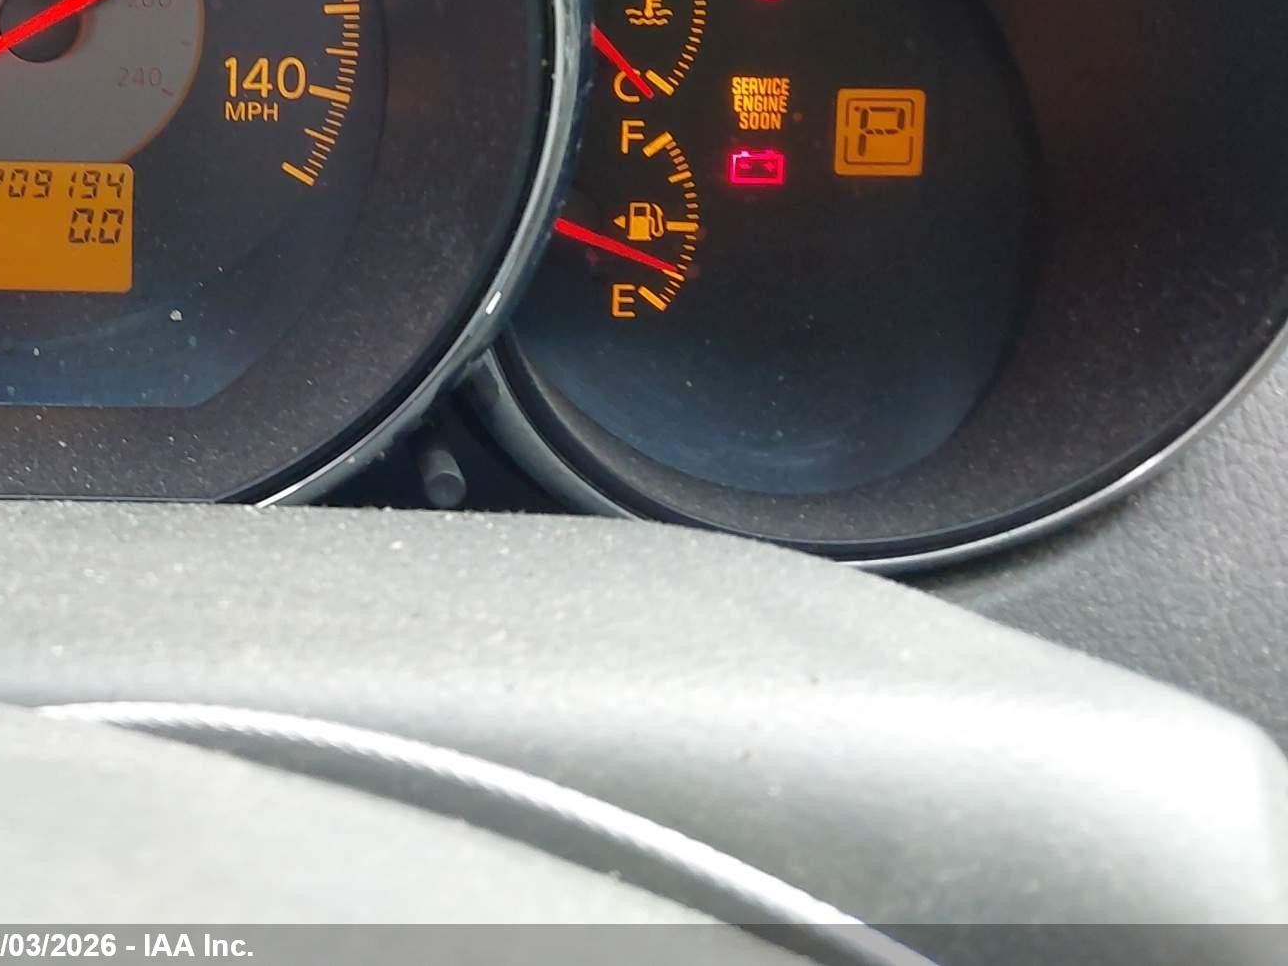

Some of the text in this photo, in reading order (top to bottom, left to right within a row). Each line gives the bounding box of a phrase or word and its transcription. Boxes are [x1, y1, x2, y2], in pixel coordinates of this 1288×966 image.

[225, 57, 307, 99] 140
[614, 69, 642, 103] C
[731, 76, 791, 95] SERVICE
[225, 101, 279, 122] MPH
[733, 95, 789, 112] ENGINE
[621, 120, 646, 154] F
[739, 112, 782, 130] SOON
[857, 106, 905, 156] P
[68, 208, 125, 244] 0.0
[612, 284, 637, 318] E
